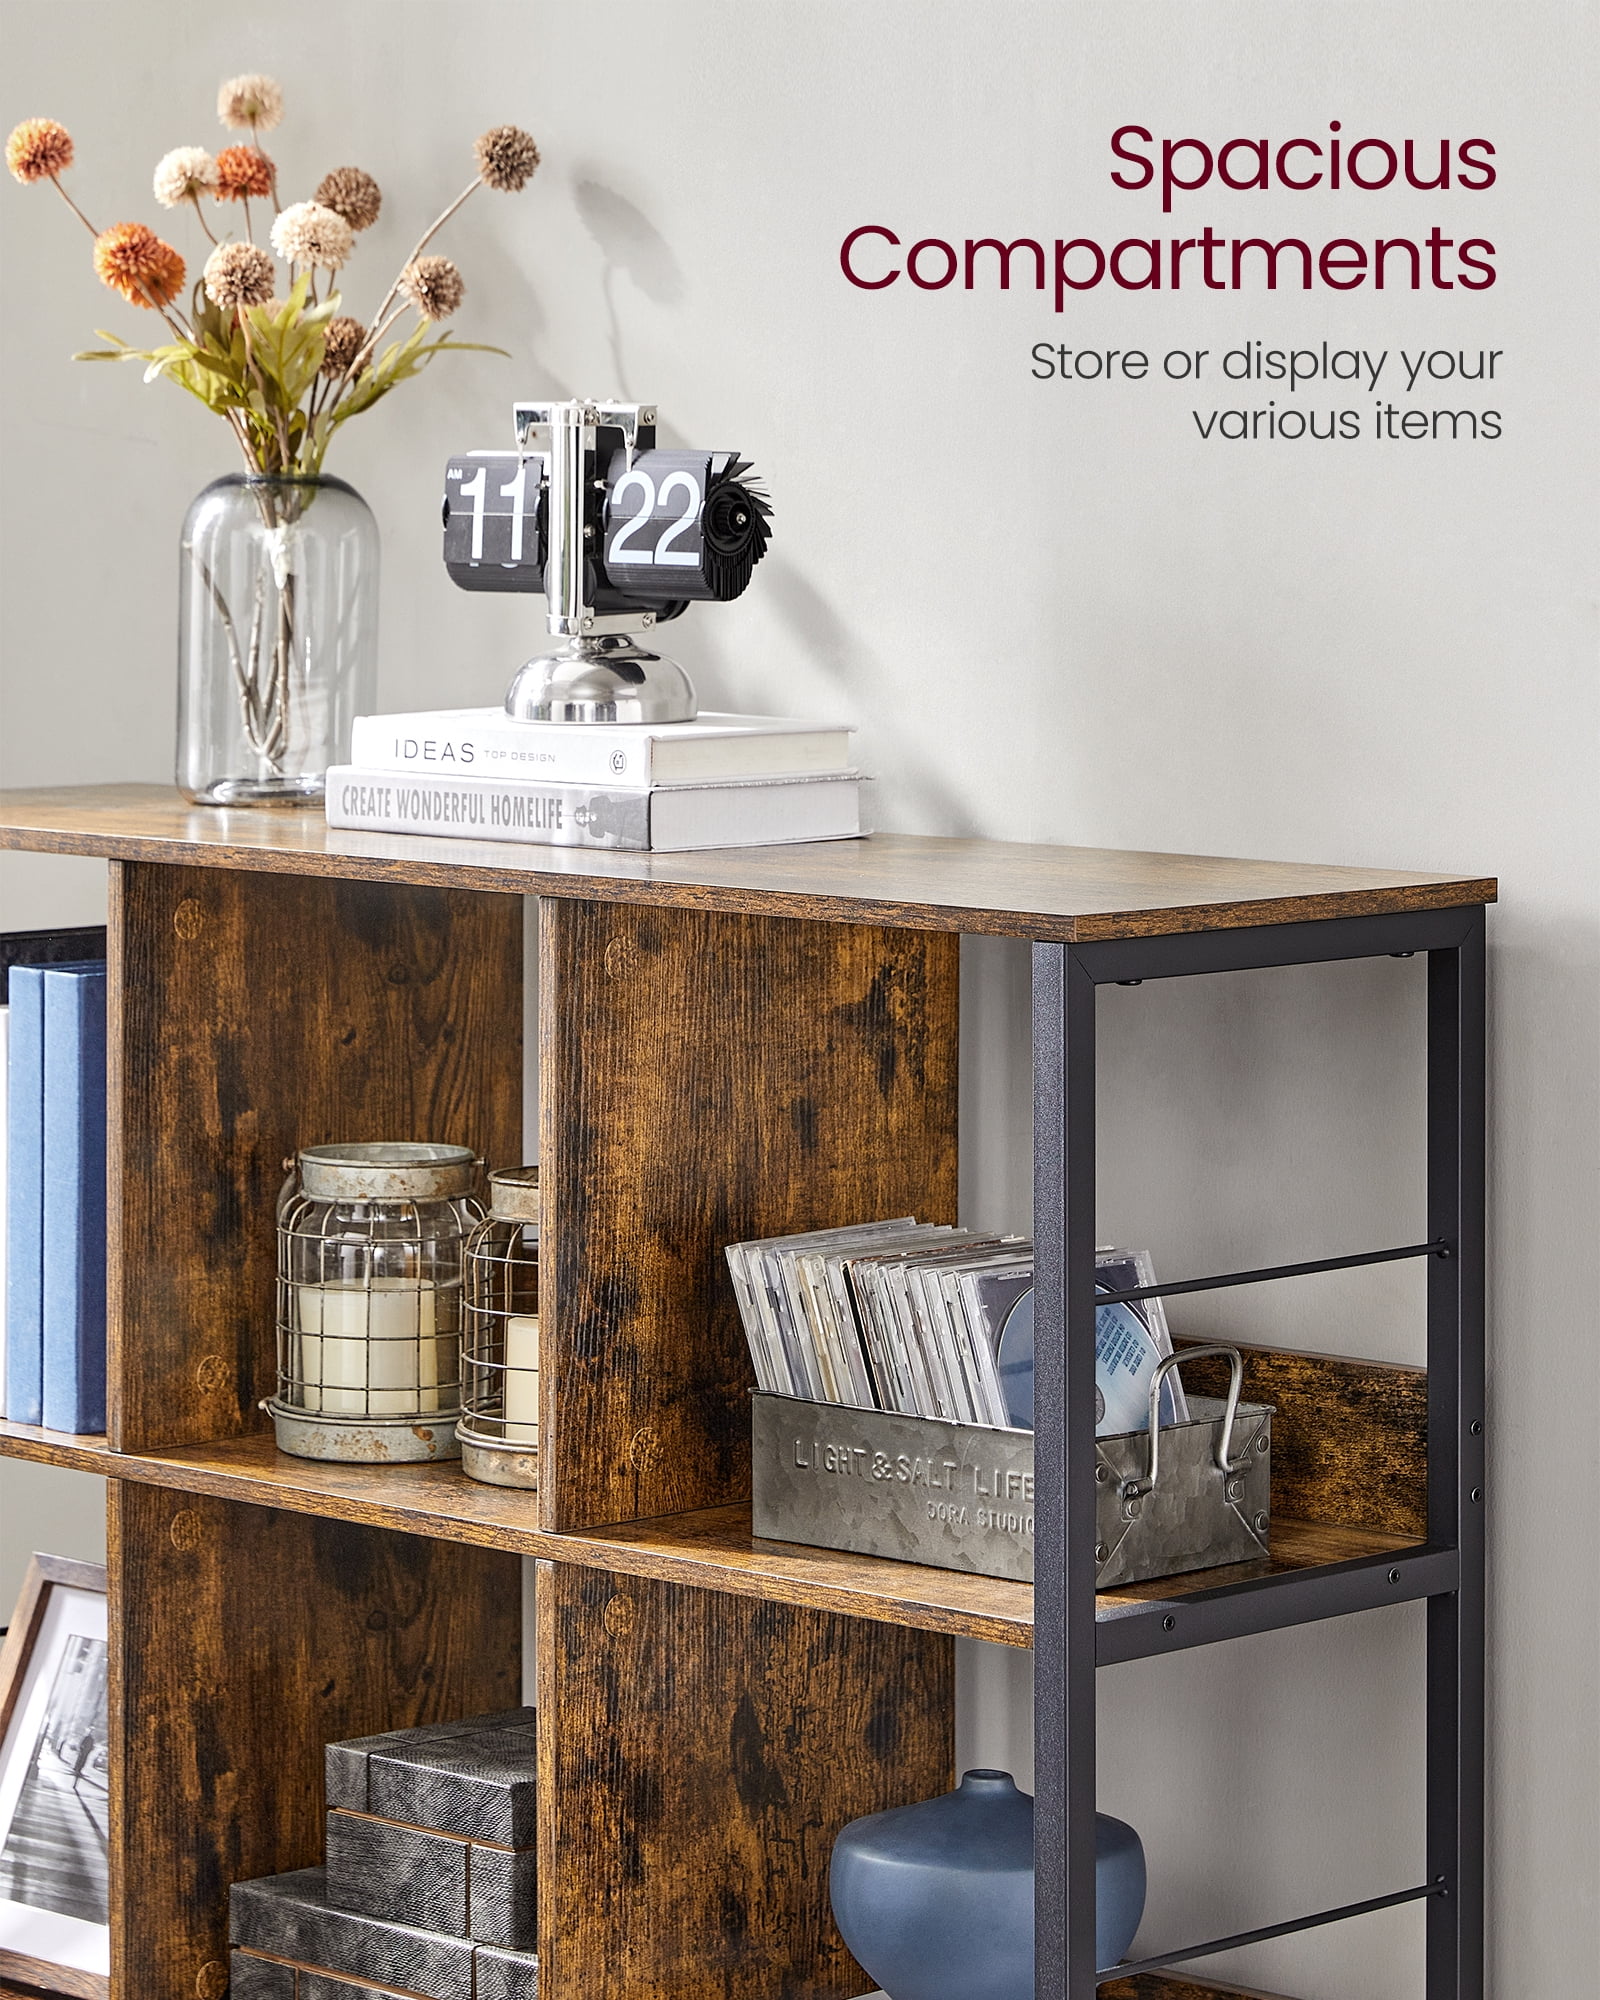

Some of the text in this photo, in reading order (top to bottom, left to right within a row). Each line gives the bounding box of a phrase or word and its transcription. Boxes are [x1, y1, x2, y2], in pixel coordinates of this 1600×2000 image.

[446, 468, 463, 480] AM
[460, 467, 700, 565] 11 22
[395, 738, 475, 763] IDEAS
[483, 750, 556, 763] TOP DESIGN
[342, 784, 563, 830] CREATE WONDERFUL HOMELIFE
[973, 1466, 1034, 1503] LIFE
